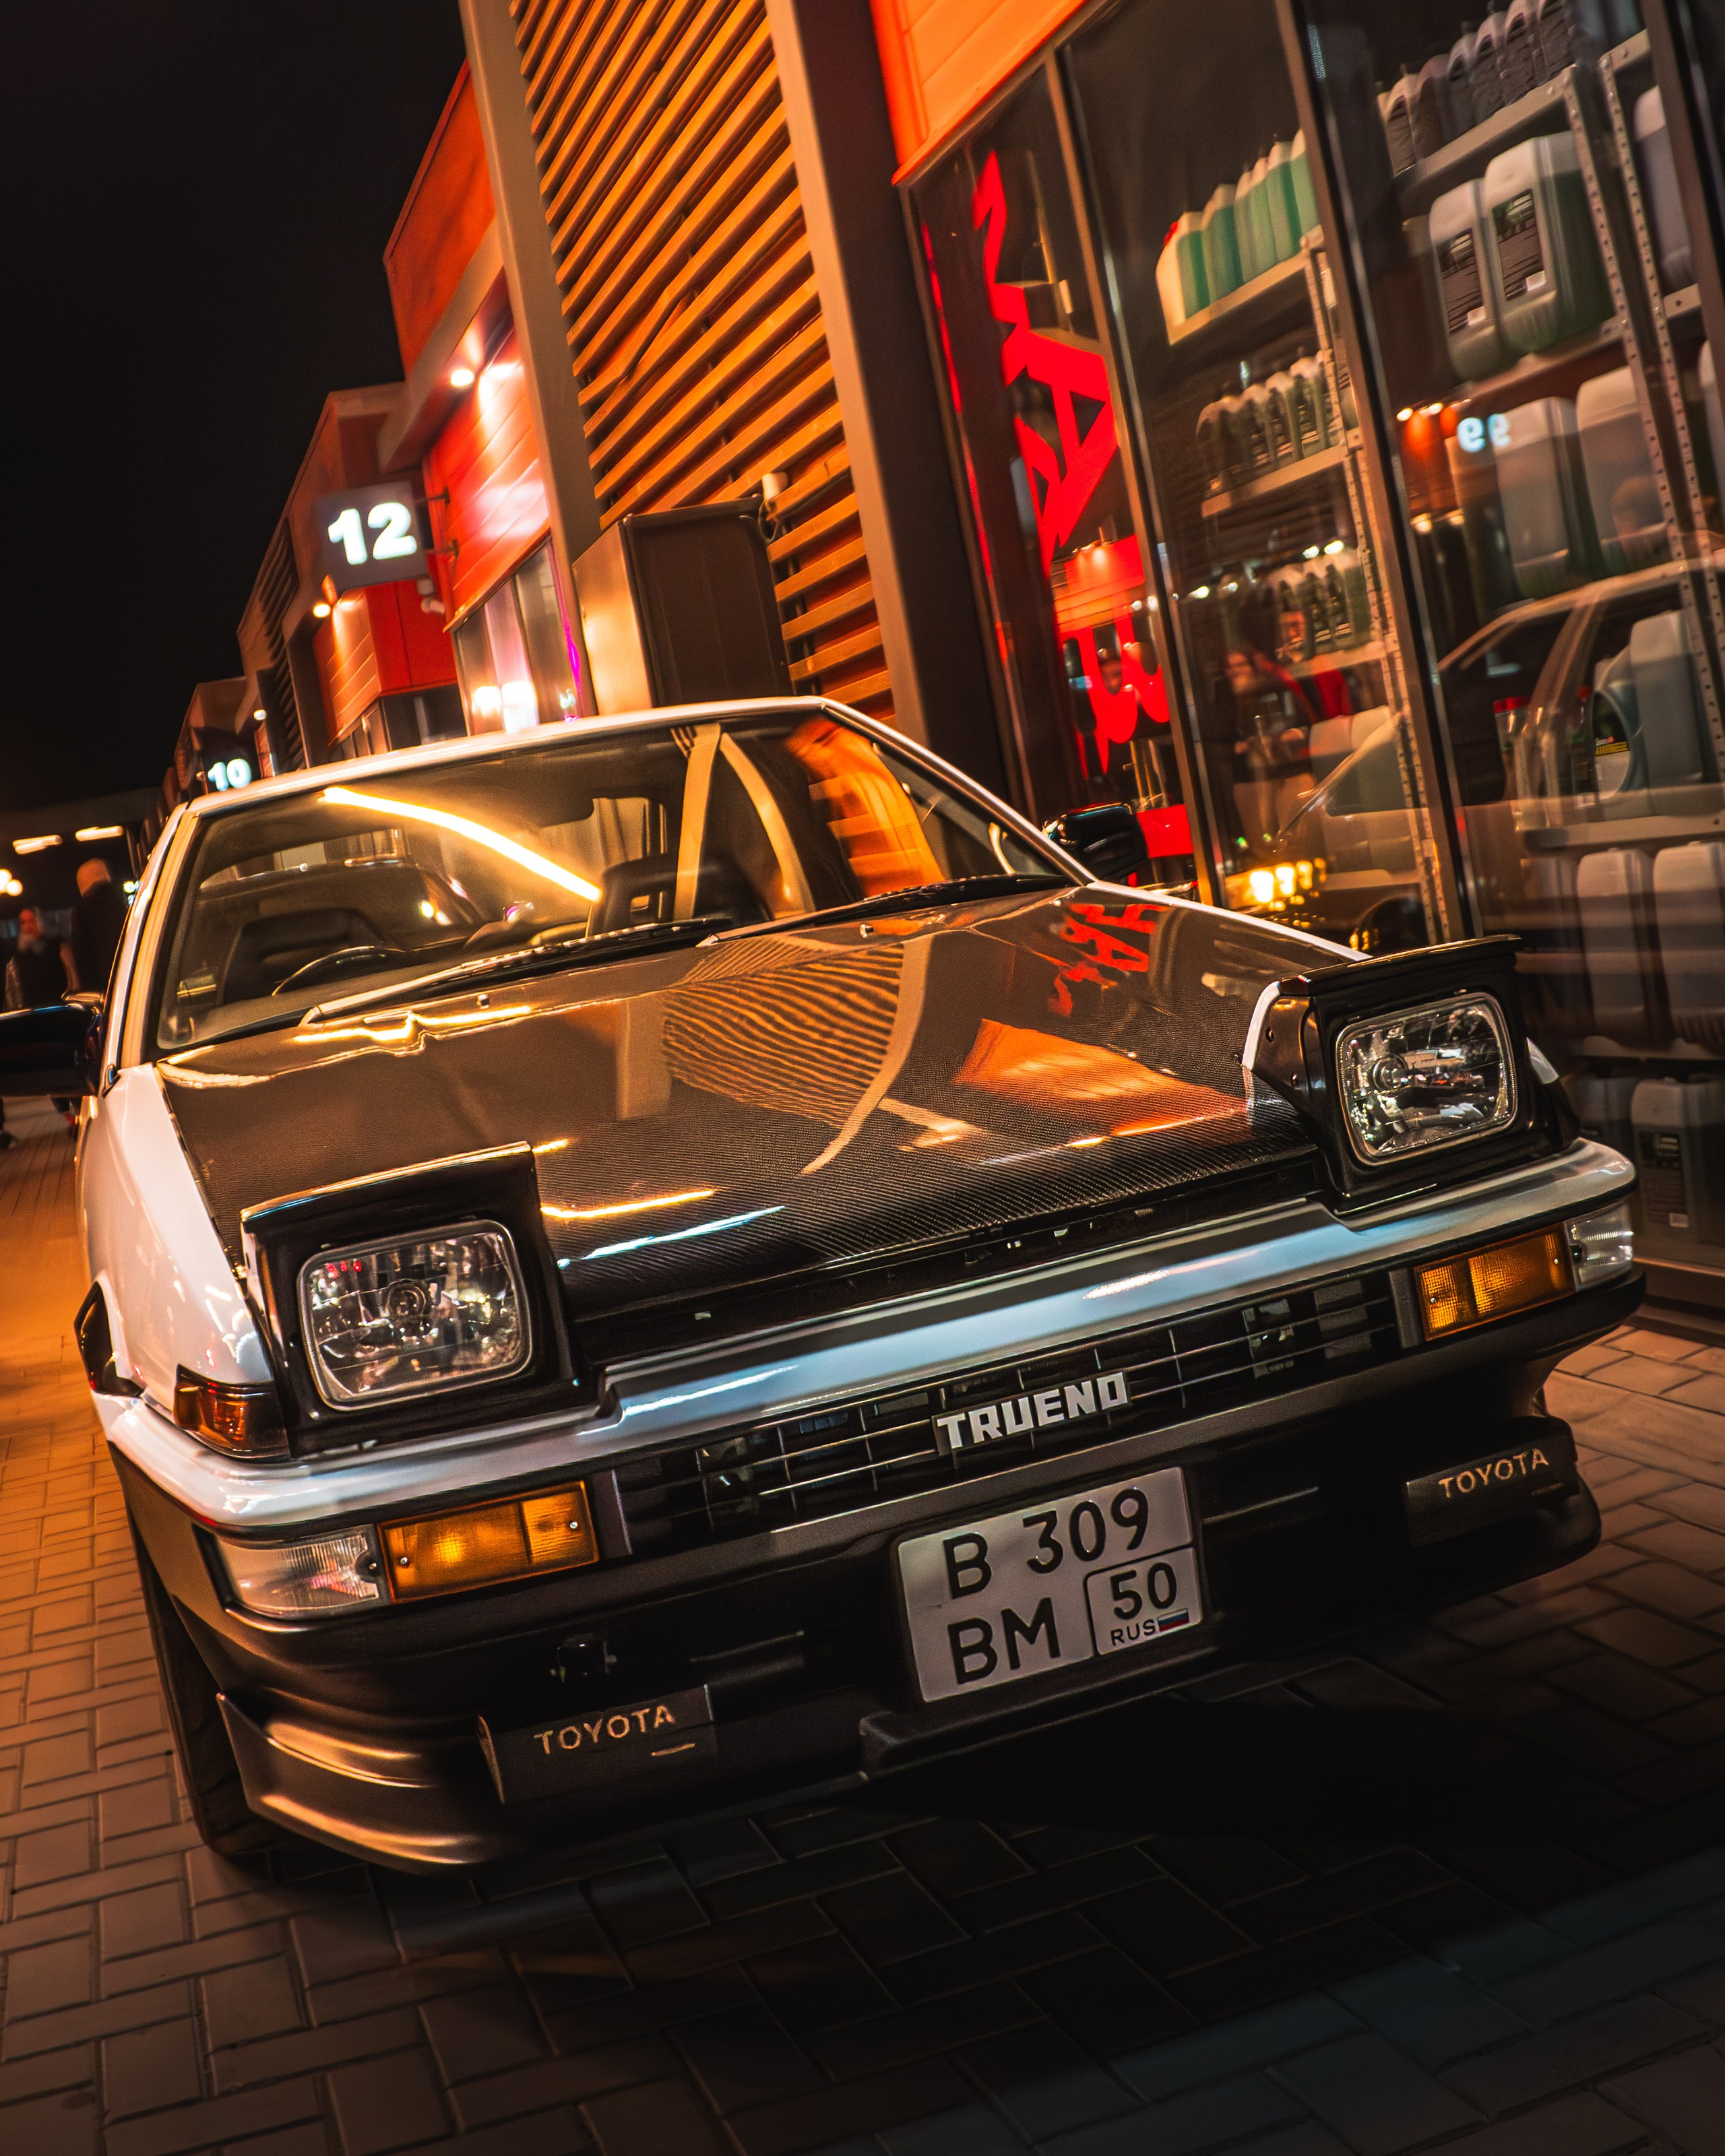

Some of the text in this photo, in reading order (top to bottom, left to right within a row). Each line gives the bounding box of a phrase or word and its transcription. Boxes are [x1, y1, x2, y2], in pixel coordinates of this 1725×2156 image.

[327, 502, 417, 565] 12
[208, 758, 252, 792] 10
[937, 1372, 1129, 1449] TRUENO
[1439, 1448, 1548, 1498] TOYOTA
[1023, 1487, 1148, 1574] 309
[1110, 1562, 1177, 1620] 50
[1110, 1620, 1156, 1646] RUS
[534, 1705, 675, 1754] TOYOTA
